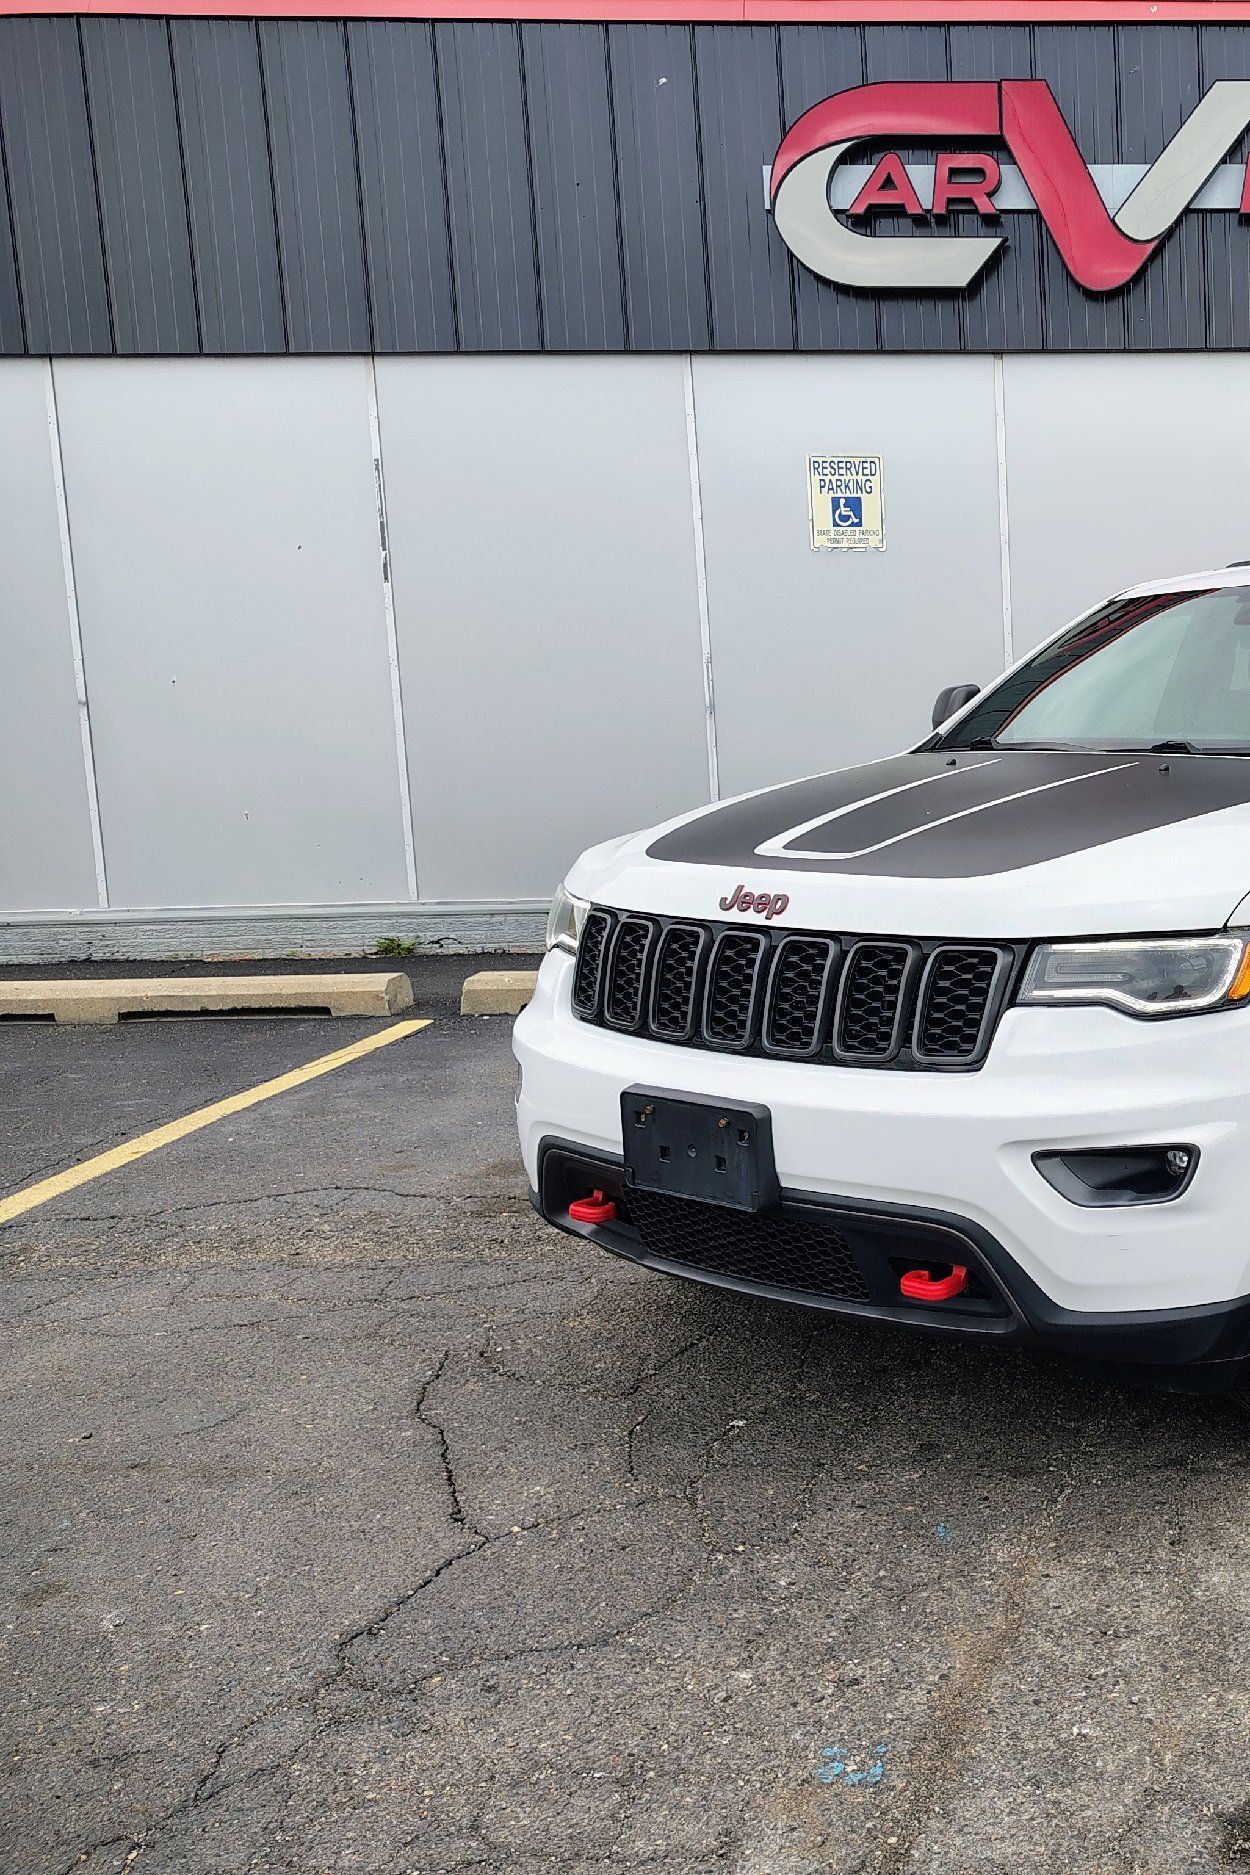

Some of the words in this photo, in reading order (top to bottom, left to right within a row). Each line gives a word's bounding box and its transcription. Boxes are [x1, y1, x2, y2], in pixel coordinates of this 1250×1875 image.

[813, 461, 877, 476] RESERVED
[819, 479, 873, 494] PARKING
[719, 885, 789, 920] Jeep
